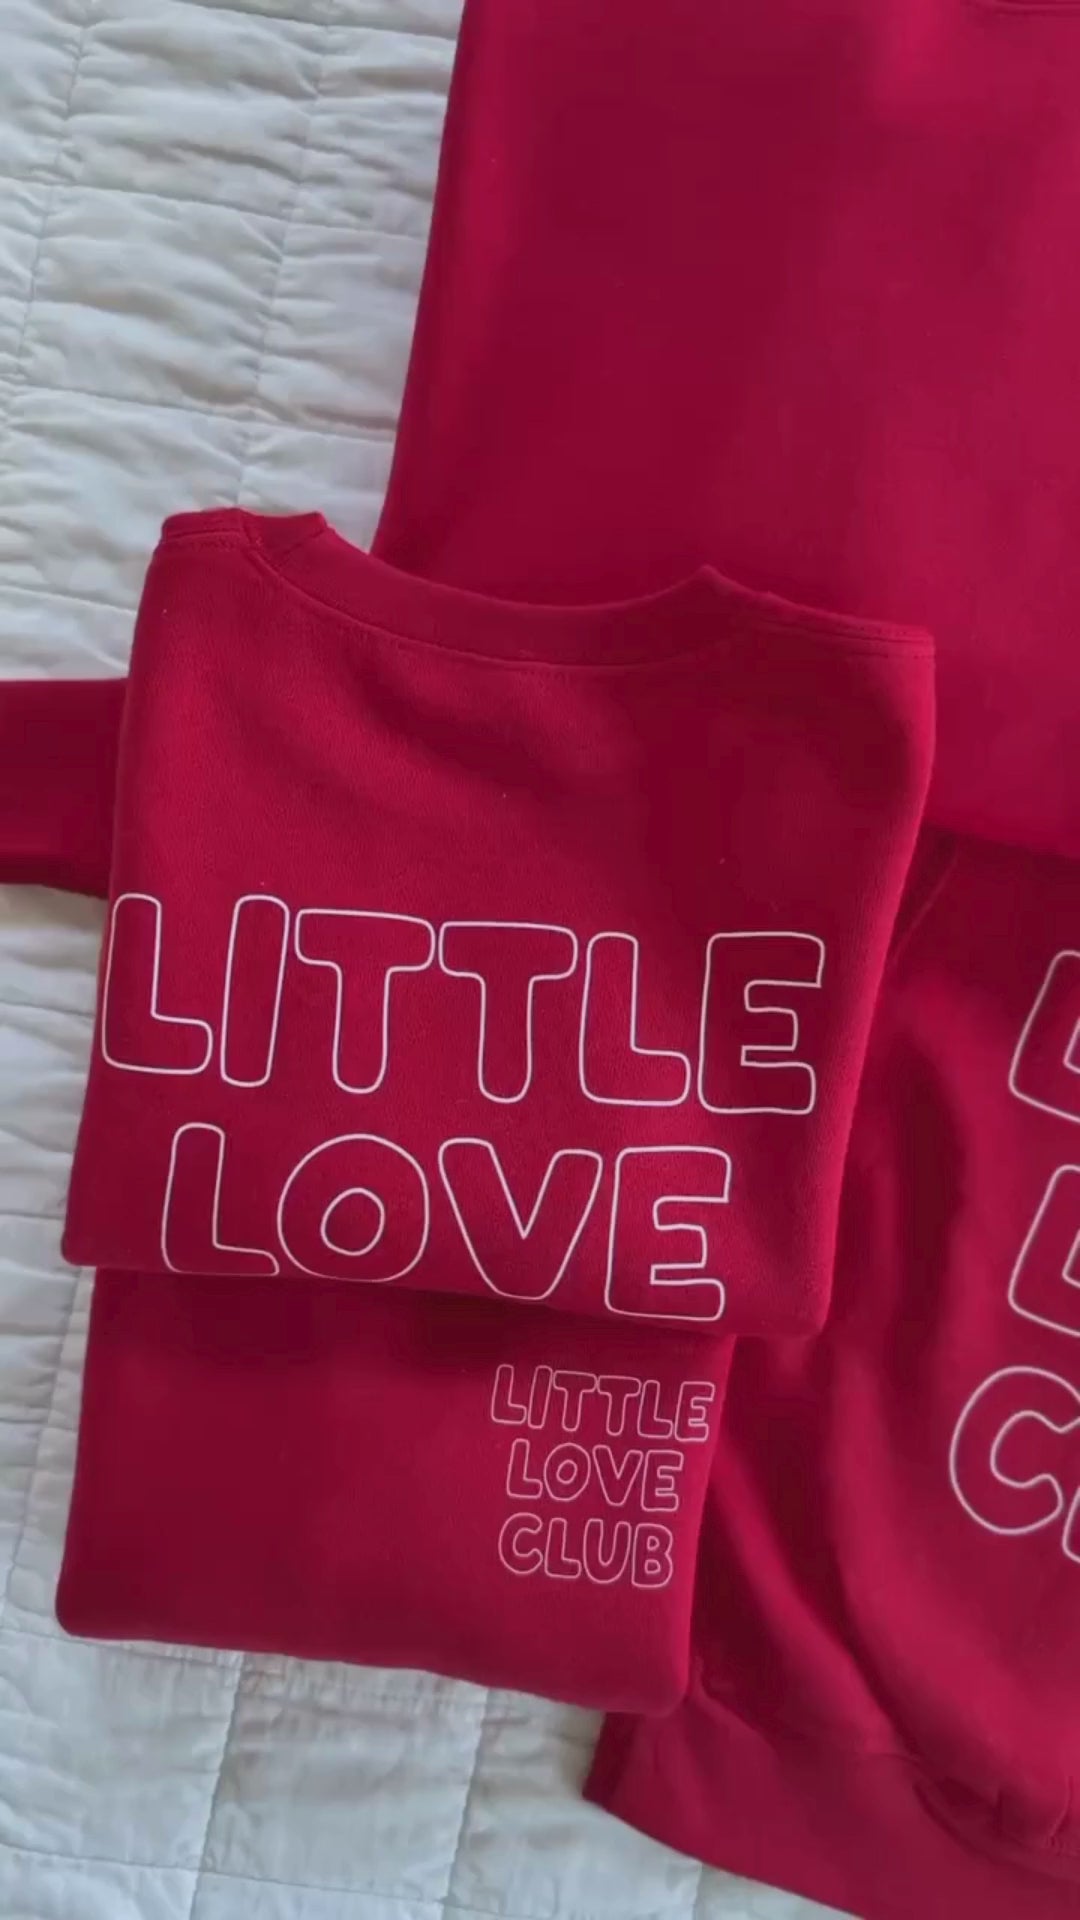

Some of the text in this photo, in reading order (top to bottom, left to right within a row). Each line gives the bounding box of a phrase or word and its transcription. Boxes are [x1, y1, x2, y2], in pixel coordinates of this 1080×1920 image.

[102, 892, 825, 1115] LITTLE
[161, 1122, 731, 1321] LOVE
[491, 1363, 716, 1442] LITTLE
[506, 1438, 684, 1512] LOVE
[498, 1512, 673, 1588] CLUB
